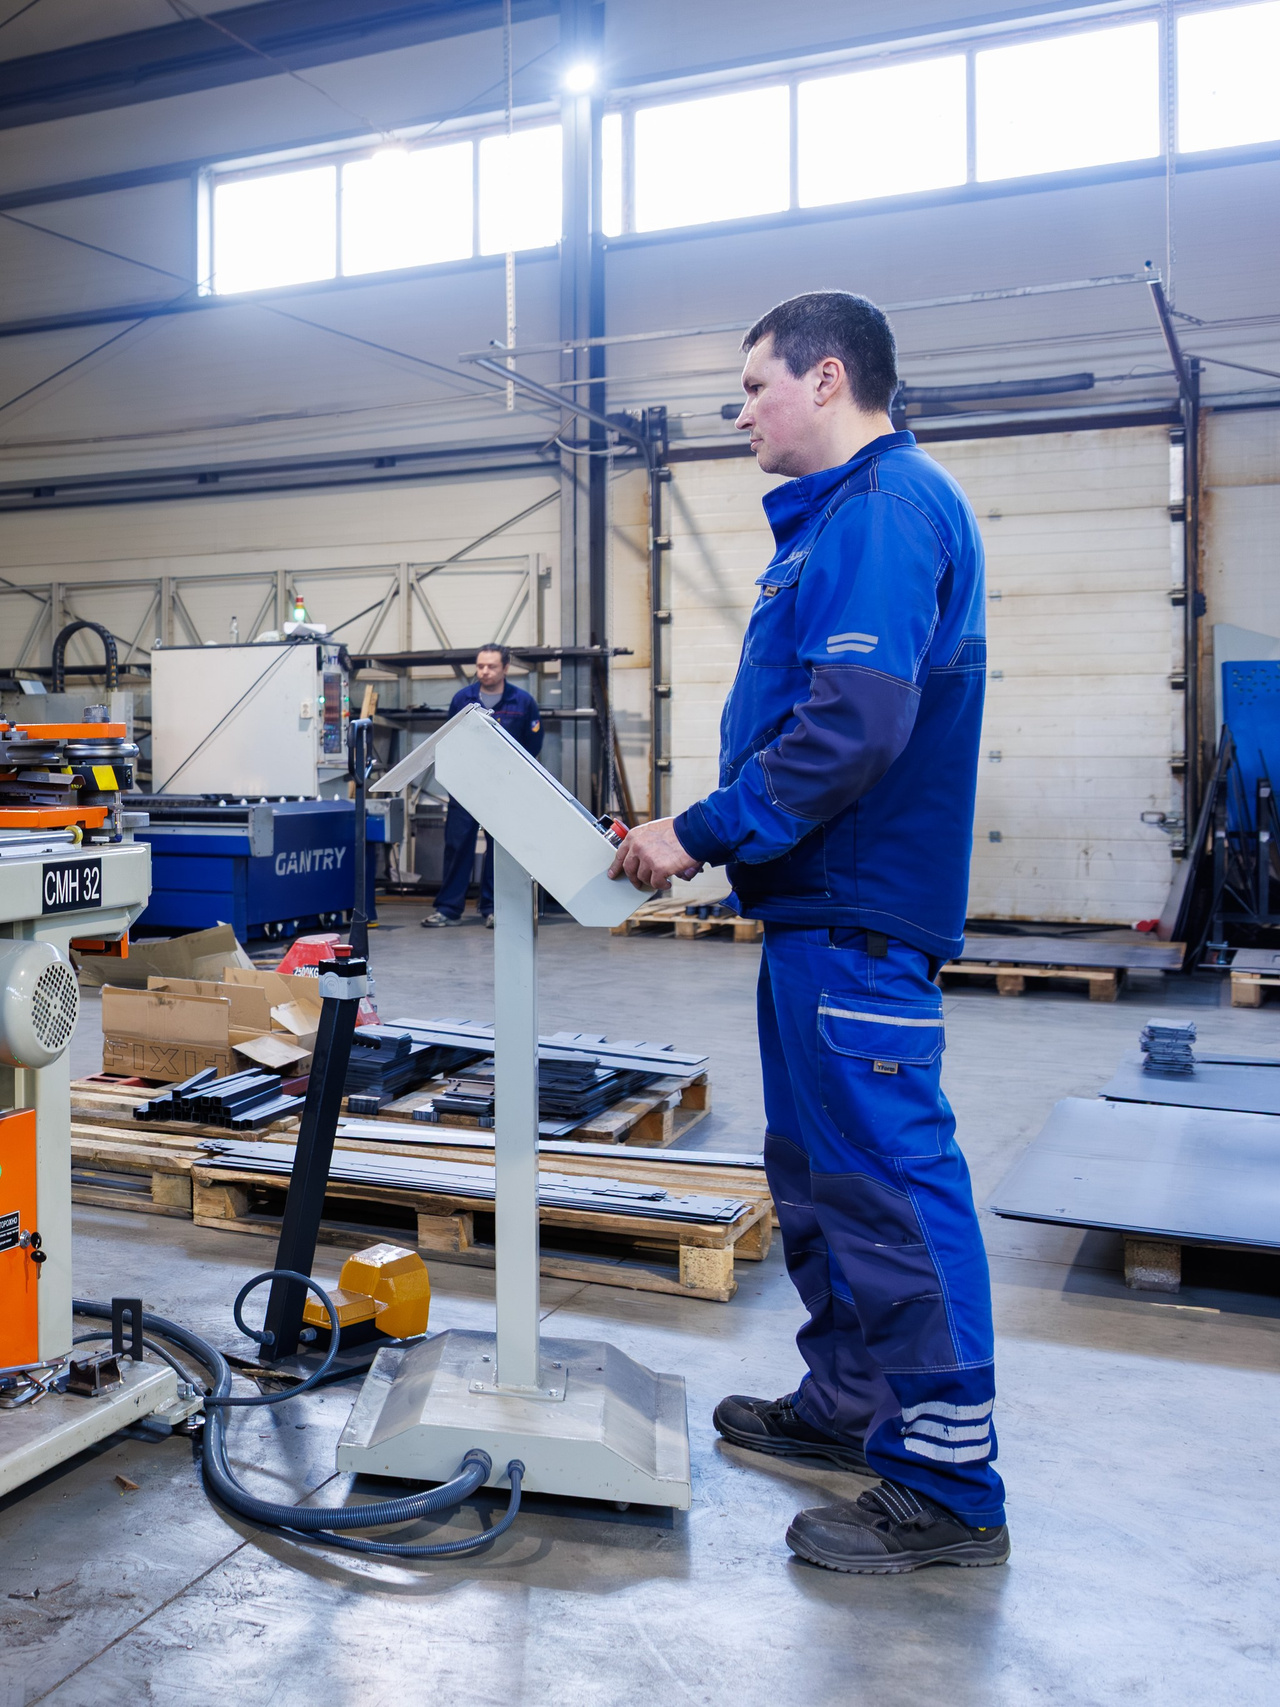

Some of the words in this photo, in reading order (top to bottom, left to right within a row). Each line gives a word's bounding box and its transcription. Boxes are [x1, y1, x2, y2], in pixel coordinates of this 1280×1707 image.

[275, 847, 347, 876] GANTRY
[44, 869, 80, 906] CMH
[82, 867, 101, 901] 32
